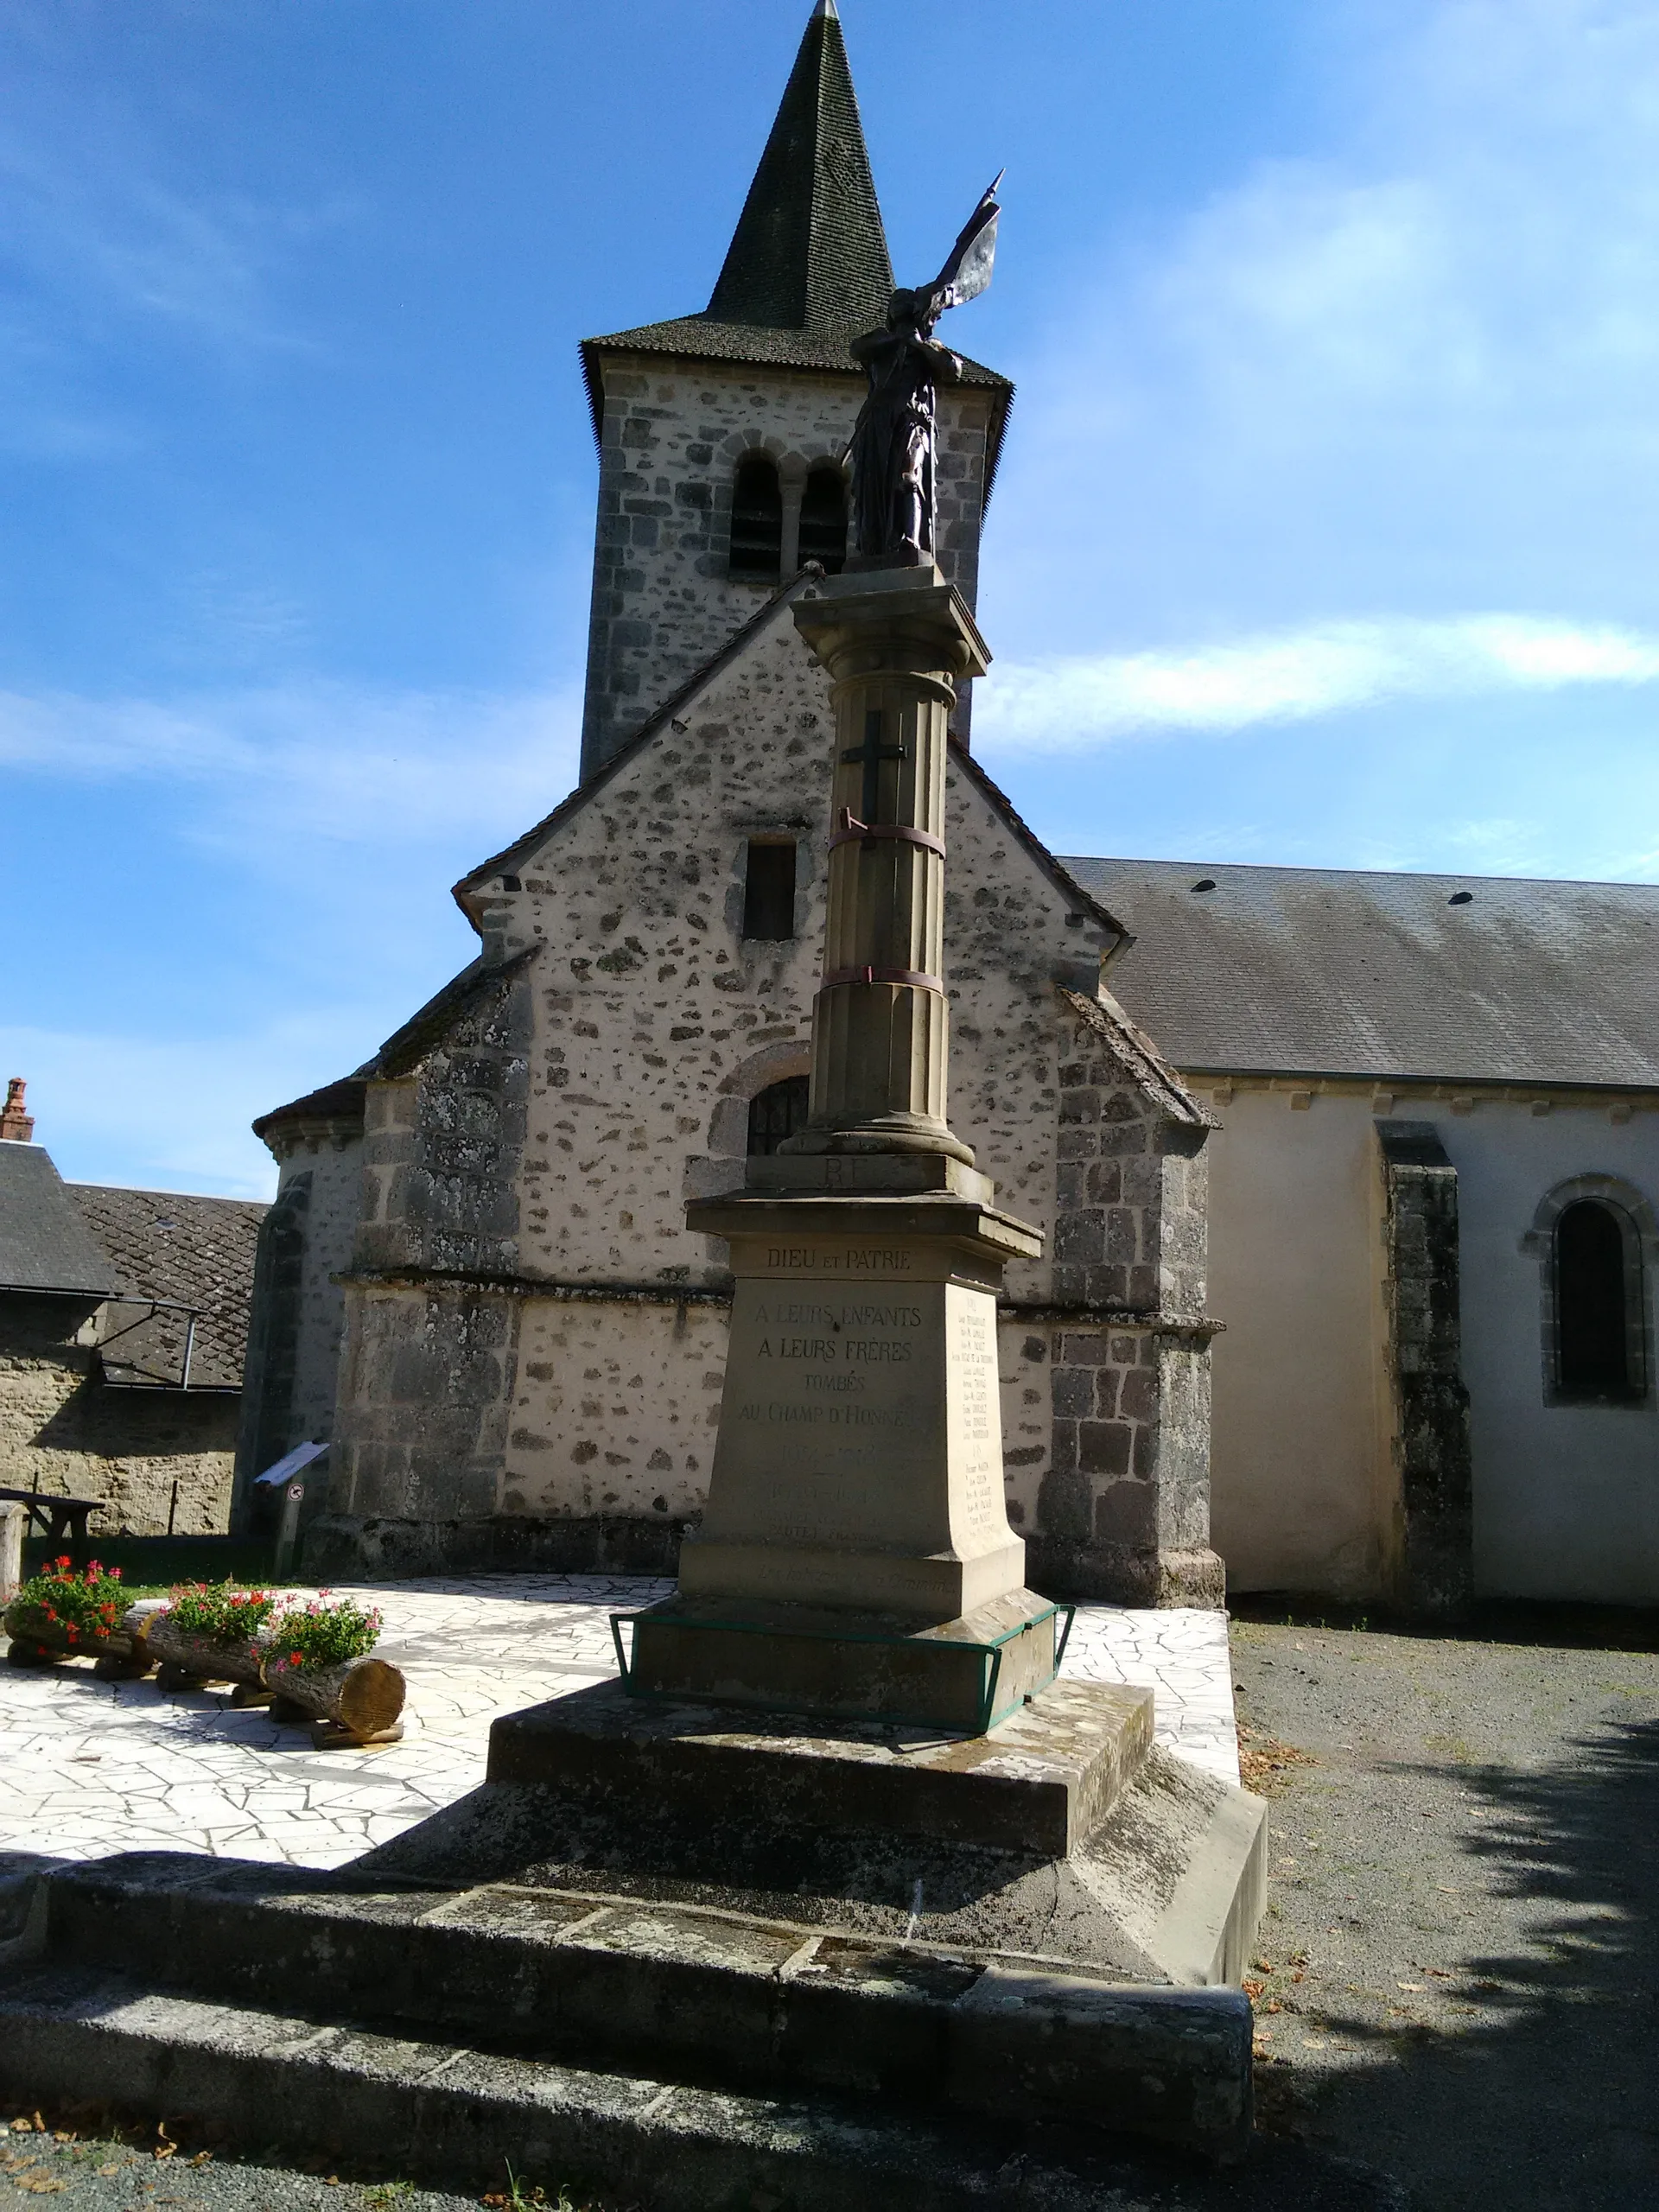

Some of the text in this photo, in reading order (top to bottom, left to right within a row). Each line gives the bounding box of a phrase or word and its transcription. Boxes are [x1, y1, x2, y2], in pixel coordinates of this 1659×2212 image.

[767, 1249, 911, 1270] DIEU ET PATRIE
[755, 1305, 923, 1327] A LEURS ENFANTS
[758, 1337, 912, 1364] A LEURS FRÈRES
[804, 1370, 866, 1394] TOMBÉS
[738, 1402, 922, 1427] AU CHAMP D'HONNE
